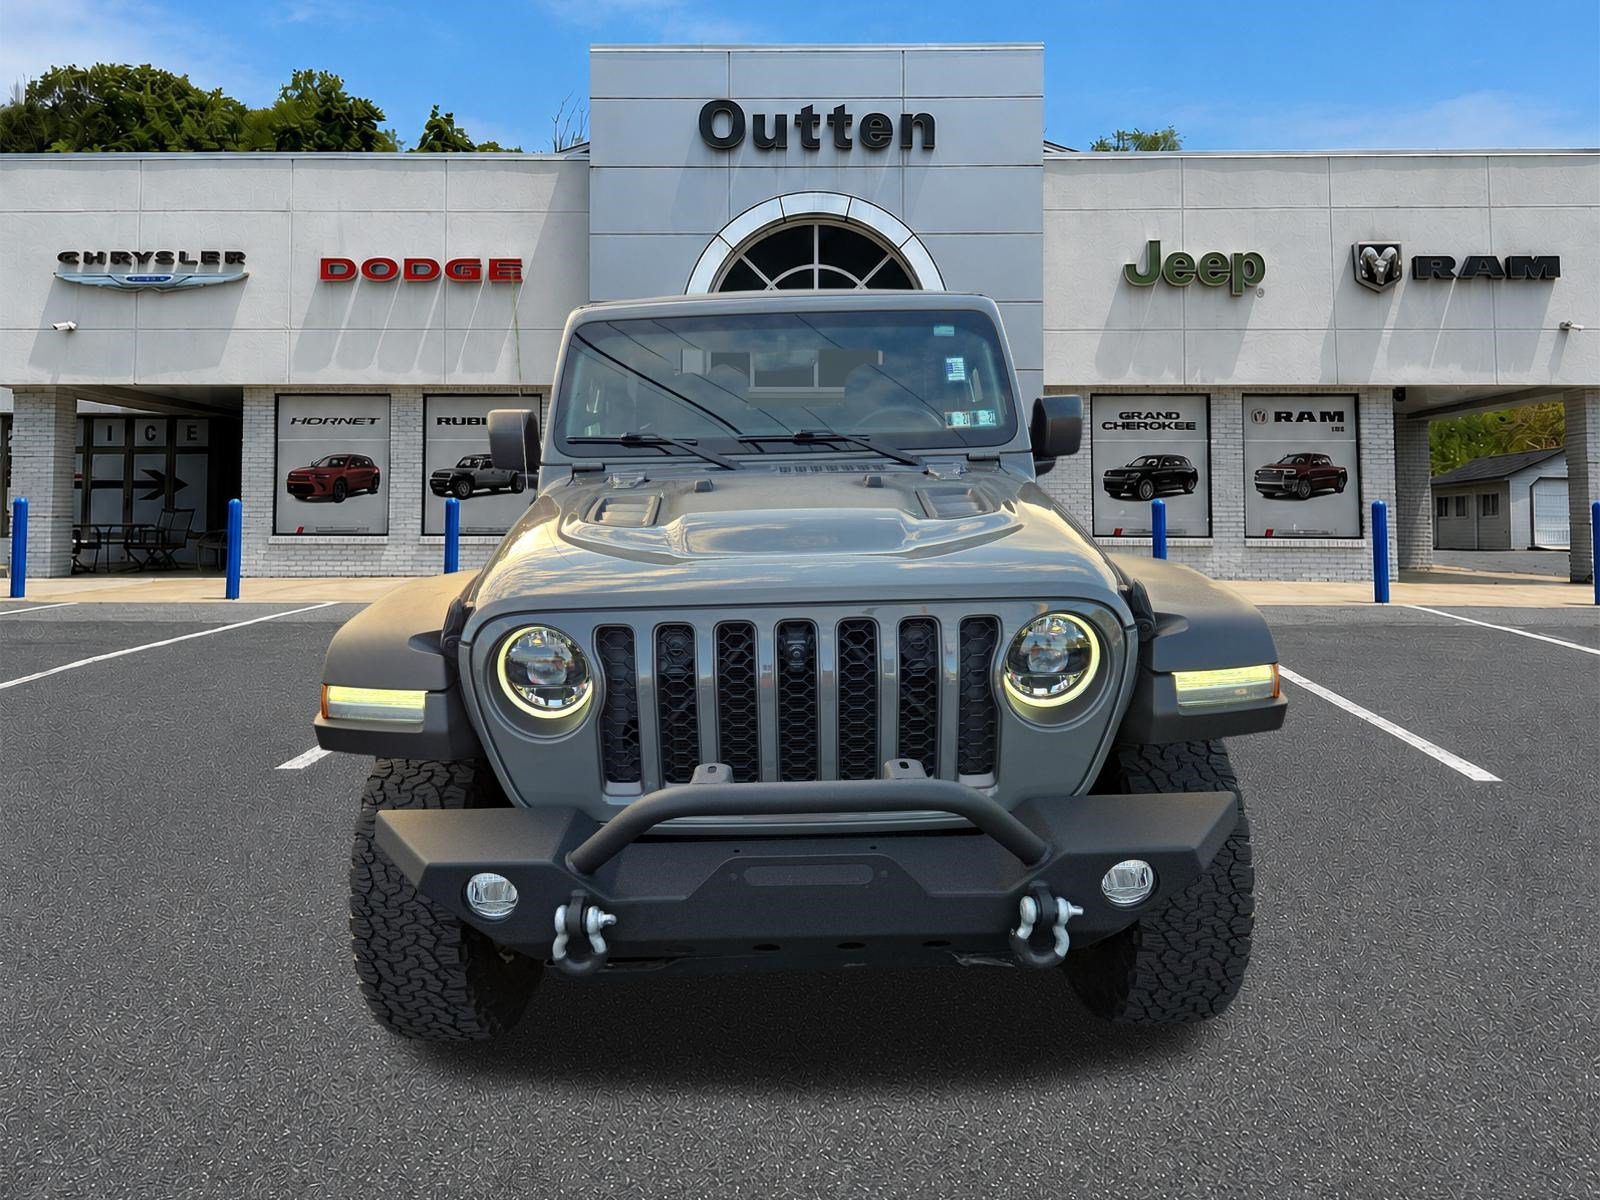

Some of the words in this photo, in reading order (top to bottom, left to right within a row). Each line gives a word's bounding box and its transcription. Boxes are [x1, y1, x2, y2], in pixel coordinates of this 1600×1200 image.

[698, 99, 936, 151] Outten
[57, 251, 247, 265] CHRYSLER
[320, 257, 524, 283] DODGE
[1123, 240, 1267, 297] Jeep
[1411, 255, 1562, 281] RAM
[290, 417, 381, 426] HORNET
[1118, 411, 1180, 421] GRAND
[1274, 410, 1345, 423] RAM
[1101, 421, 1197, 431] CHEROKEE
